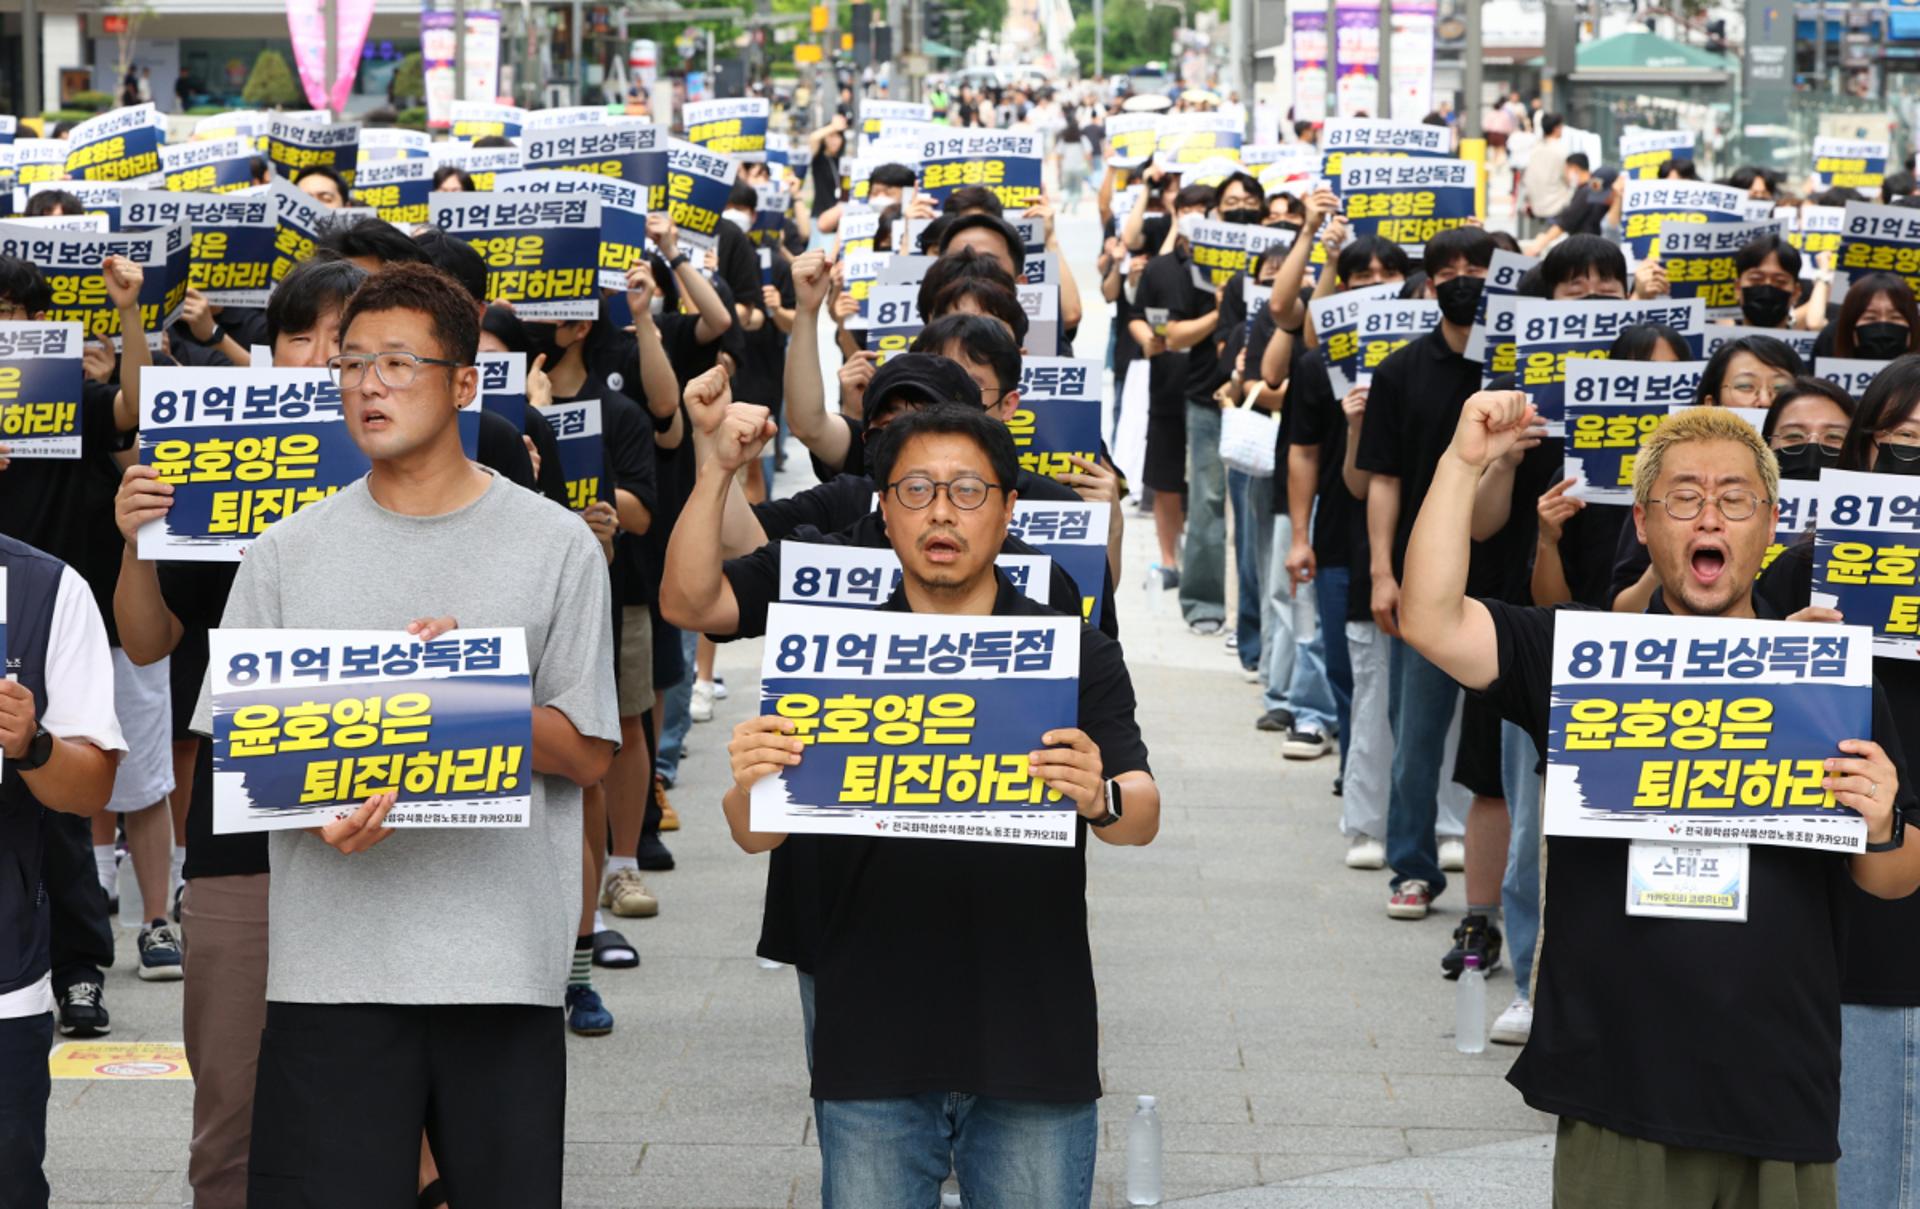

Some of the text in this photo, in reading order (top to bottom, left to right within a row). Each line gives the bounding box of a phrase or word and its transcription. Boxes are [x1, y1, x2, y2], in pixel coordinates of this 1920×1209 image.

[272, 122, 305, 138] 81억
[529, 129, 656, 161] 81억 보상독점
[1329, 128, 1440, 150] 81억 보상독점
[923, 136, 1033, 158] 81억 보상독점
[923, 160, 1006, 190] 윤호영은
[1347, 166, 1392, 187] 81억
[1396, 164, 1466, 185] 보상독점
[128, 202, 268, 224] 81억 보상독점
[1346, 191, 1436, 219] 윤호영은
[1628, 188, 1738, 211] 81억 보상독점
[438, 200, 587, 230] 81억 보상독점
[1850, 215, 1902, 239] 81억
[1665, 232, 1712, 252] 81억
[1365, 311, 1415, 332] 81억
[1525, 313, 1588, 342] 81억
[1573, 373, 1639, 403] 81억
[151, 386, 237, 425] 81억
[151, 433, 320, 485] 윤호영은
[792, 566, 882, 606] 81억
[227, 636, 502, 688] 81억 보상독점
[775, 628, 1056, 678] 81억 보상독점
[1567, 637, 1849, 682] 81억 보상독점
[228, 692, 433, 759] 윤호영은
[774, 693, 977, 747] 윤호영은
[1564, 697, 1774, 752] 윤호영은
[299, 744, 524, 805] 퇴진하라!
